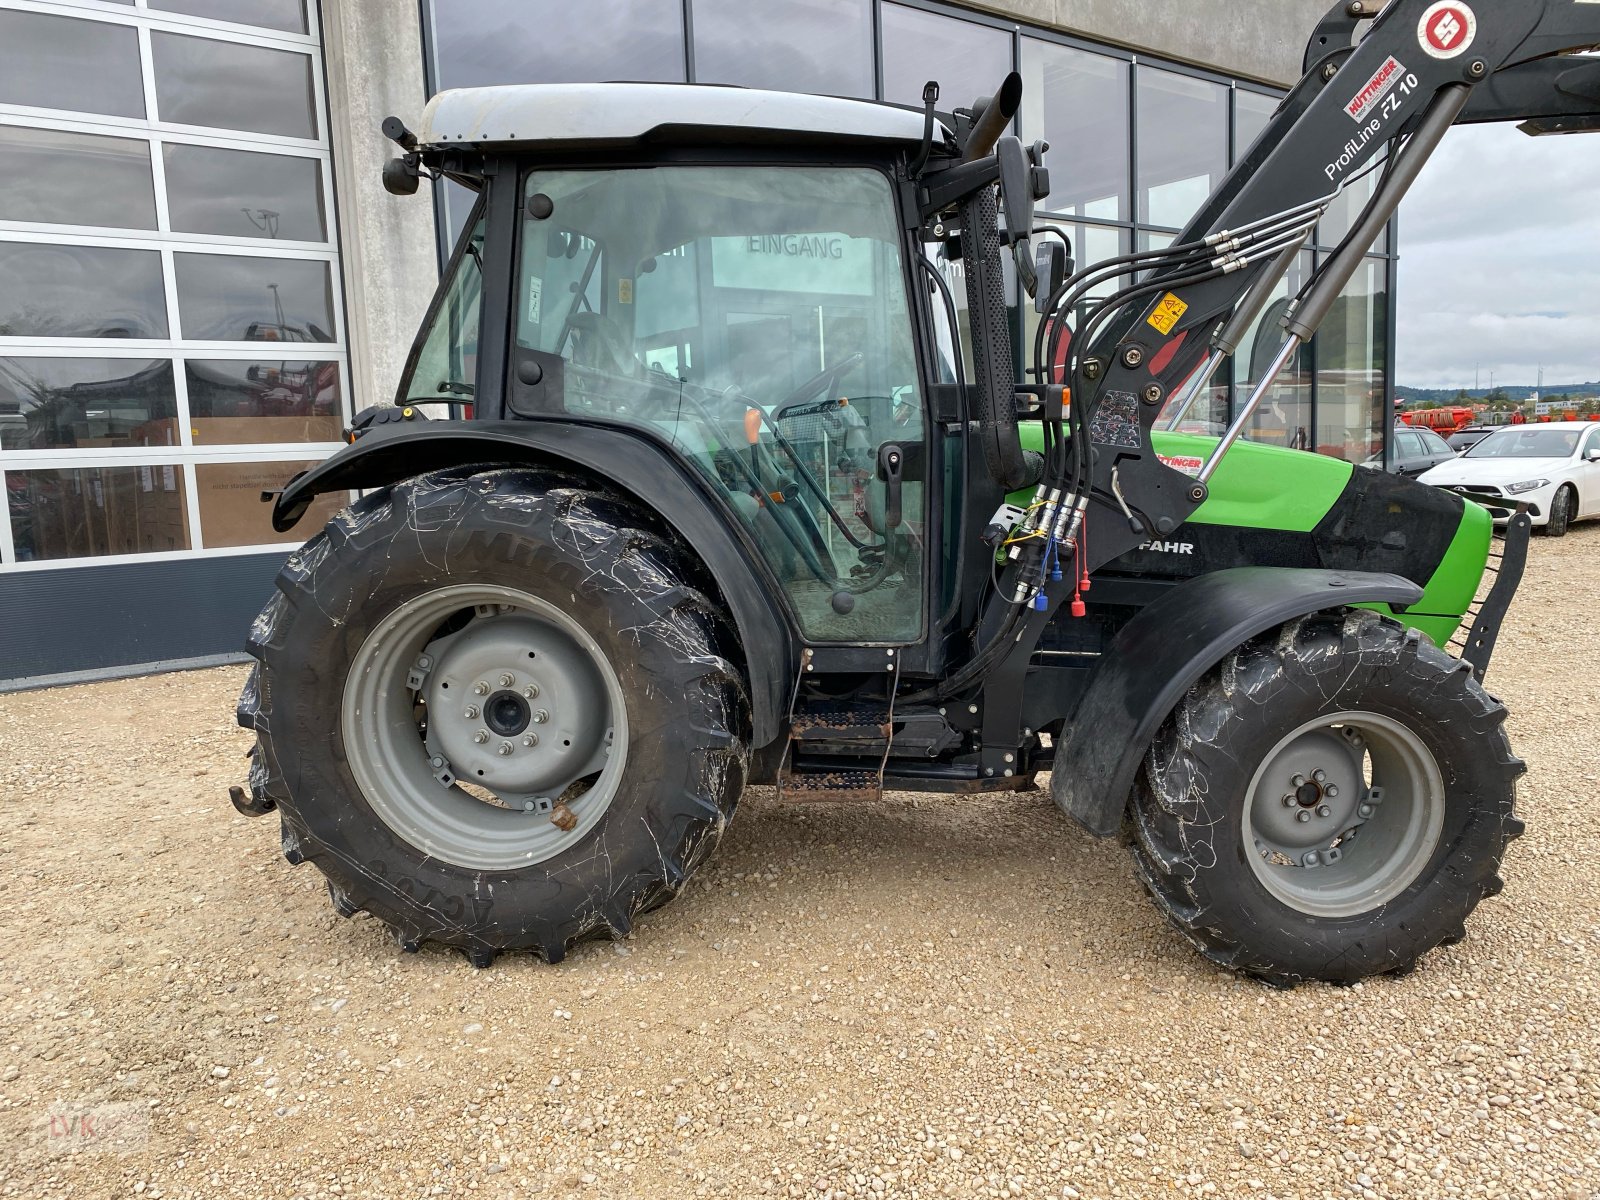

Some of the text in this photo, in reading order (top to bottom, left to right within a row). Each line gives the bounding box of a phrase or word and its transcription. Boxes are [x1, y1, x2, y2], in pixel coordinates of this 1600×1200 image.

[1324, 118, 1381, 181] ProfiLine
[1380, 92, 1402, 120] FZ
[1399, 73, 1418, 95] 10
[746, 234, 843, 259] EINGANG
[1138, 540, 1194, 555] FAHR
